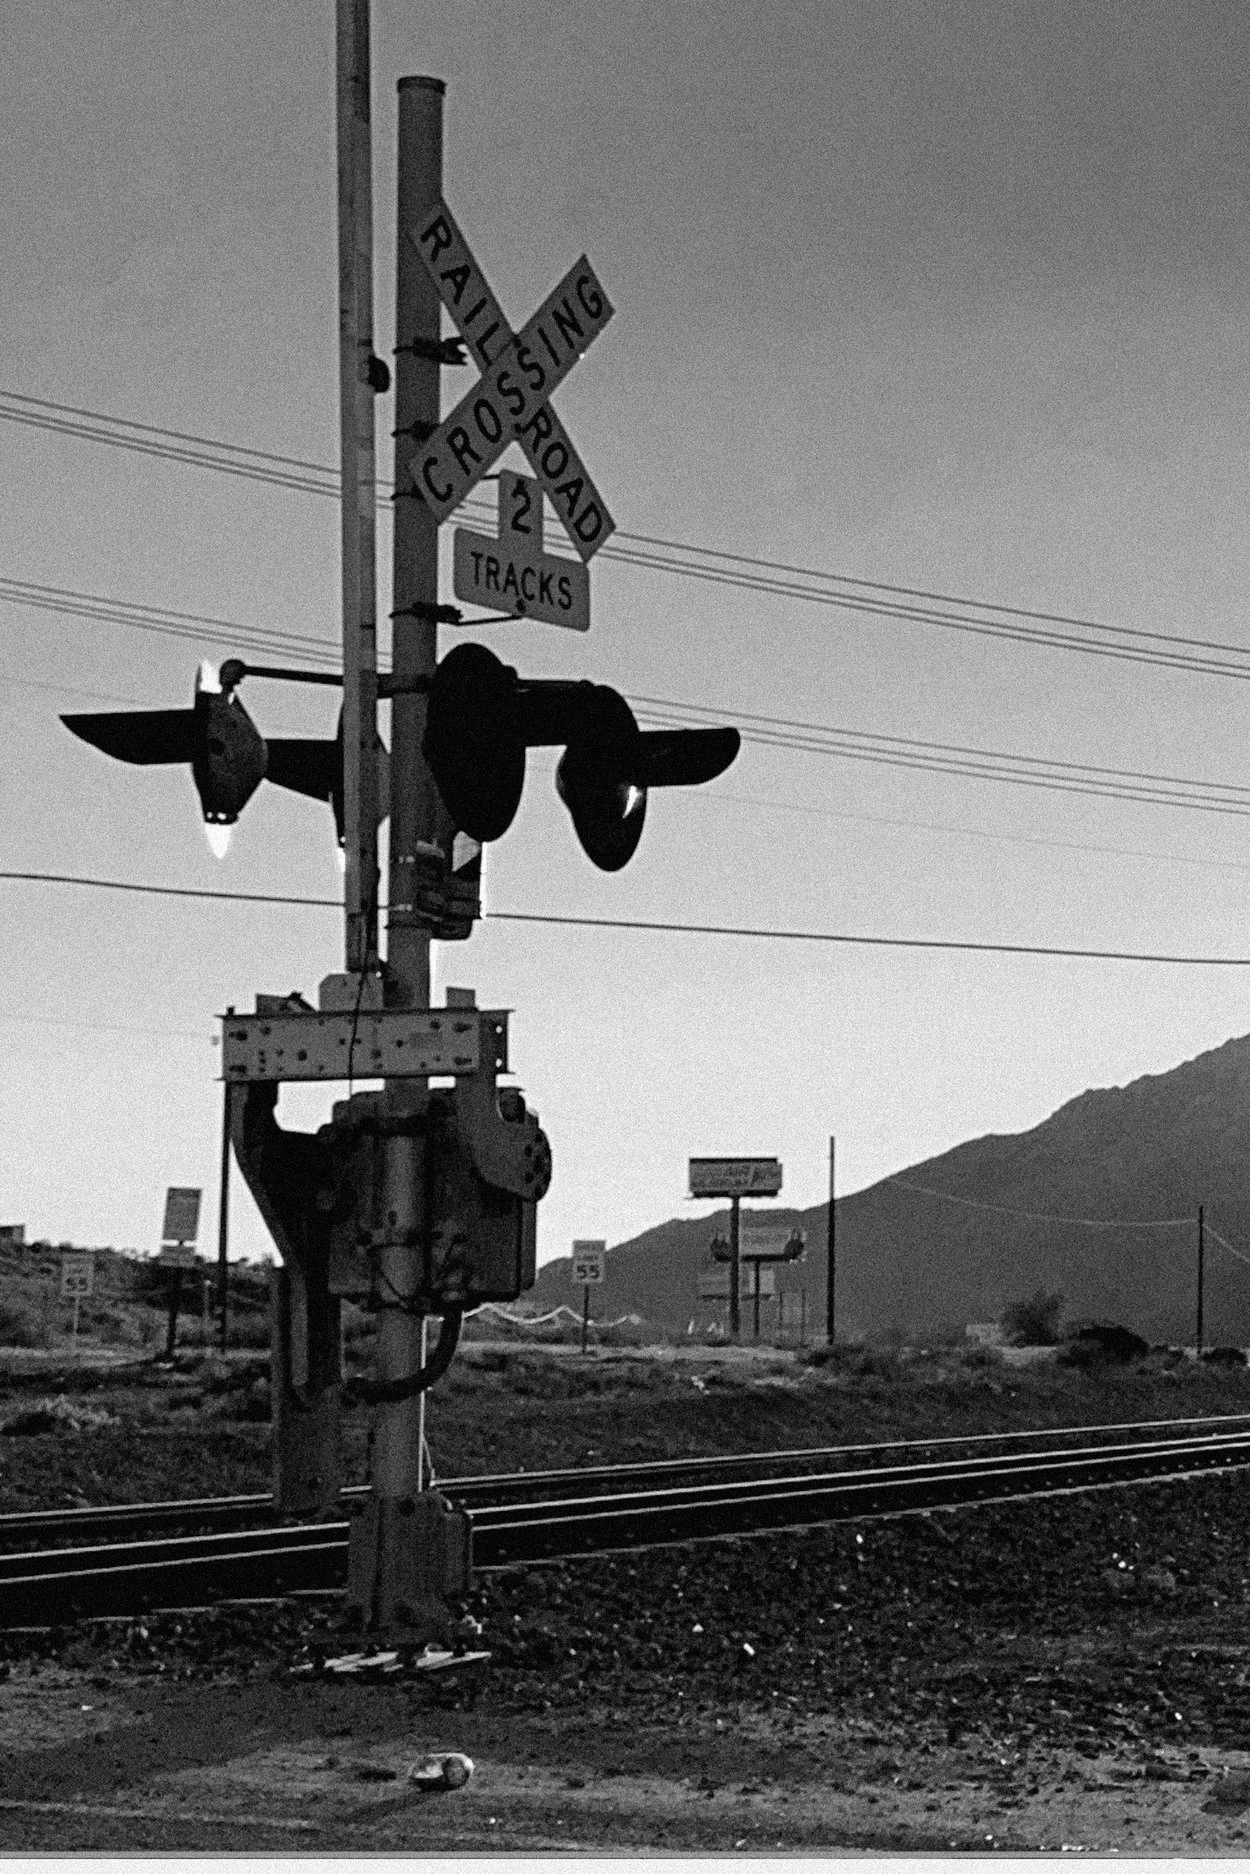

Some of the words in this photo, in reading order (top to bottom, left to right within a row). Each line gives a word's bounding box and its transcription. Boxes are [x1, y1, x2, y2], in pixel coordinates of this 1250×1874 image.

[420, 215, 500, 366] RAIL
[522, 407, 604, 543] ROAD
[422, 275, 603, 502] CROSSING
[511, 479, 532, 534] 2
[470, 551, 573, 611] TRACKS
[577, 1264, 600, 1279] 55
